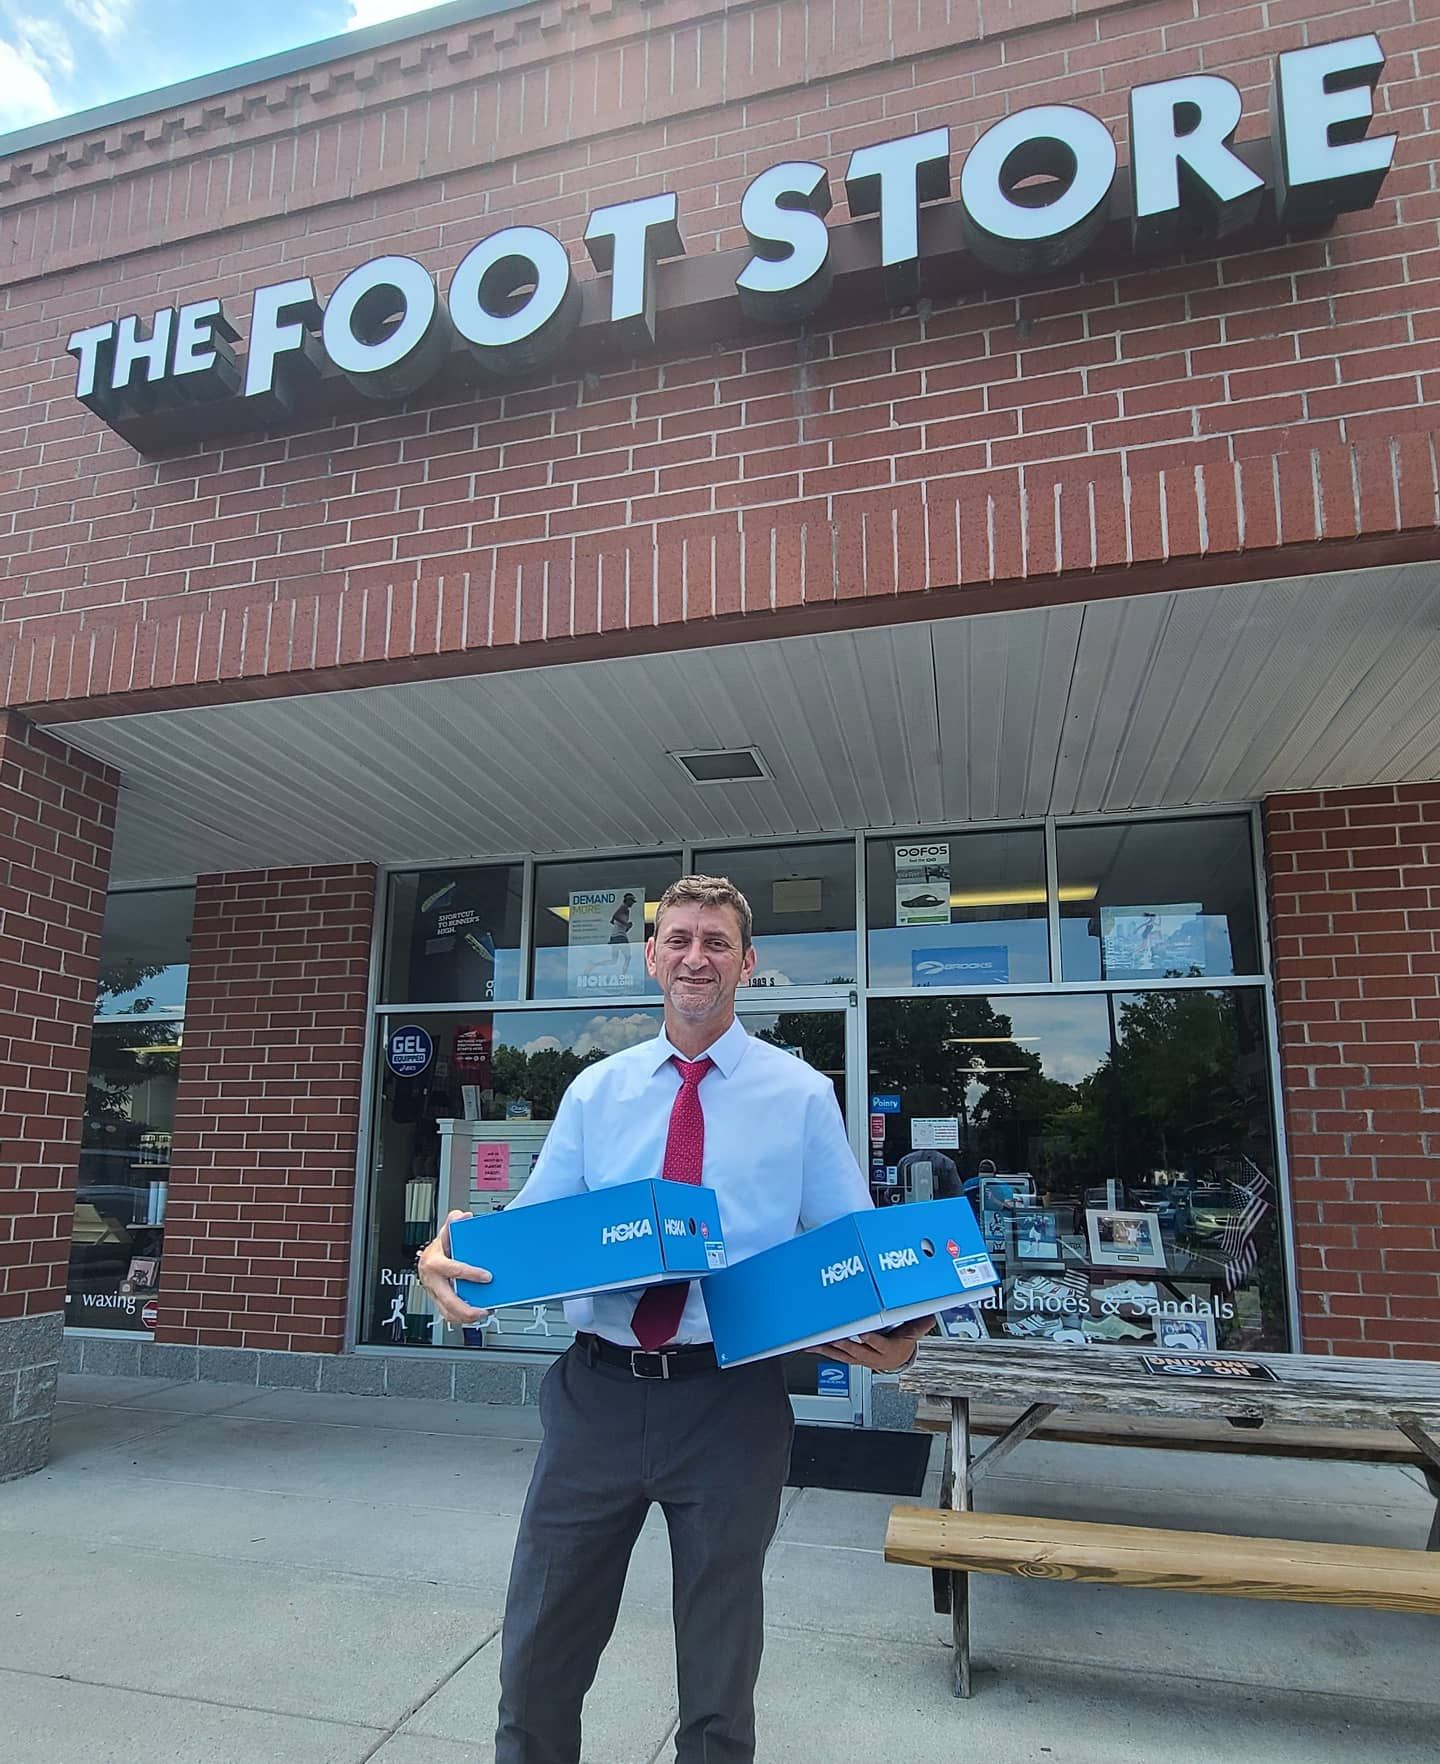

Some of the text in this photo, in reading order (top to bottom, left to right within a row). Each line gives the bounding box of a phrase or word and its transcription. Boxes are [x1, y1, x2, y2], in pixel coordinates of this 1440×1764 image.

[66, 33, 1398, 399] THE FOOT STORE
[897, 846, 948, 857] OOFOS
[573, 893, 616, 905] DEMAND
[438, 909, 476, 922] SHORTCUT
[573, 904, 601, 914] MORE
[438, 920, 448, 929] TO
[943, 961, 993, 970] BROOKS
[392, 1035, 427, 1053] GEL
[394, 1054, 425, 1063] EQUIPPED
[872, 1096, 898, 1108] Pointy
[602, 1218, 653, 1245] HOKA
[664, 1218, 687, 1236] HOKA
[878, 1248, 919, 1271] HOKA
[380, 1268, 417, 1286] Run
[820, 1255, 865, 1287] HOKA
[82, 1290, 136, 1315] waxing
[1013, 1288, 1090, 1313] Shoes
[1100, 1297, 1121, 1315] &
[1131, 1294, 1235, 1319] Sandals
[1150, 1356, 1261, 1369] SMOKING
[1213, 1367, 1250, 1376] NO
